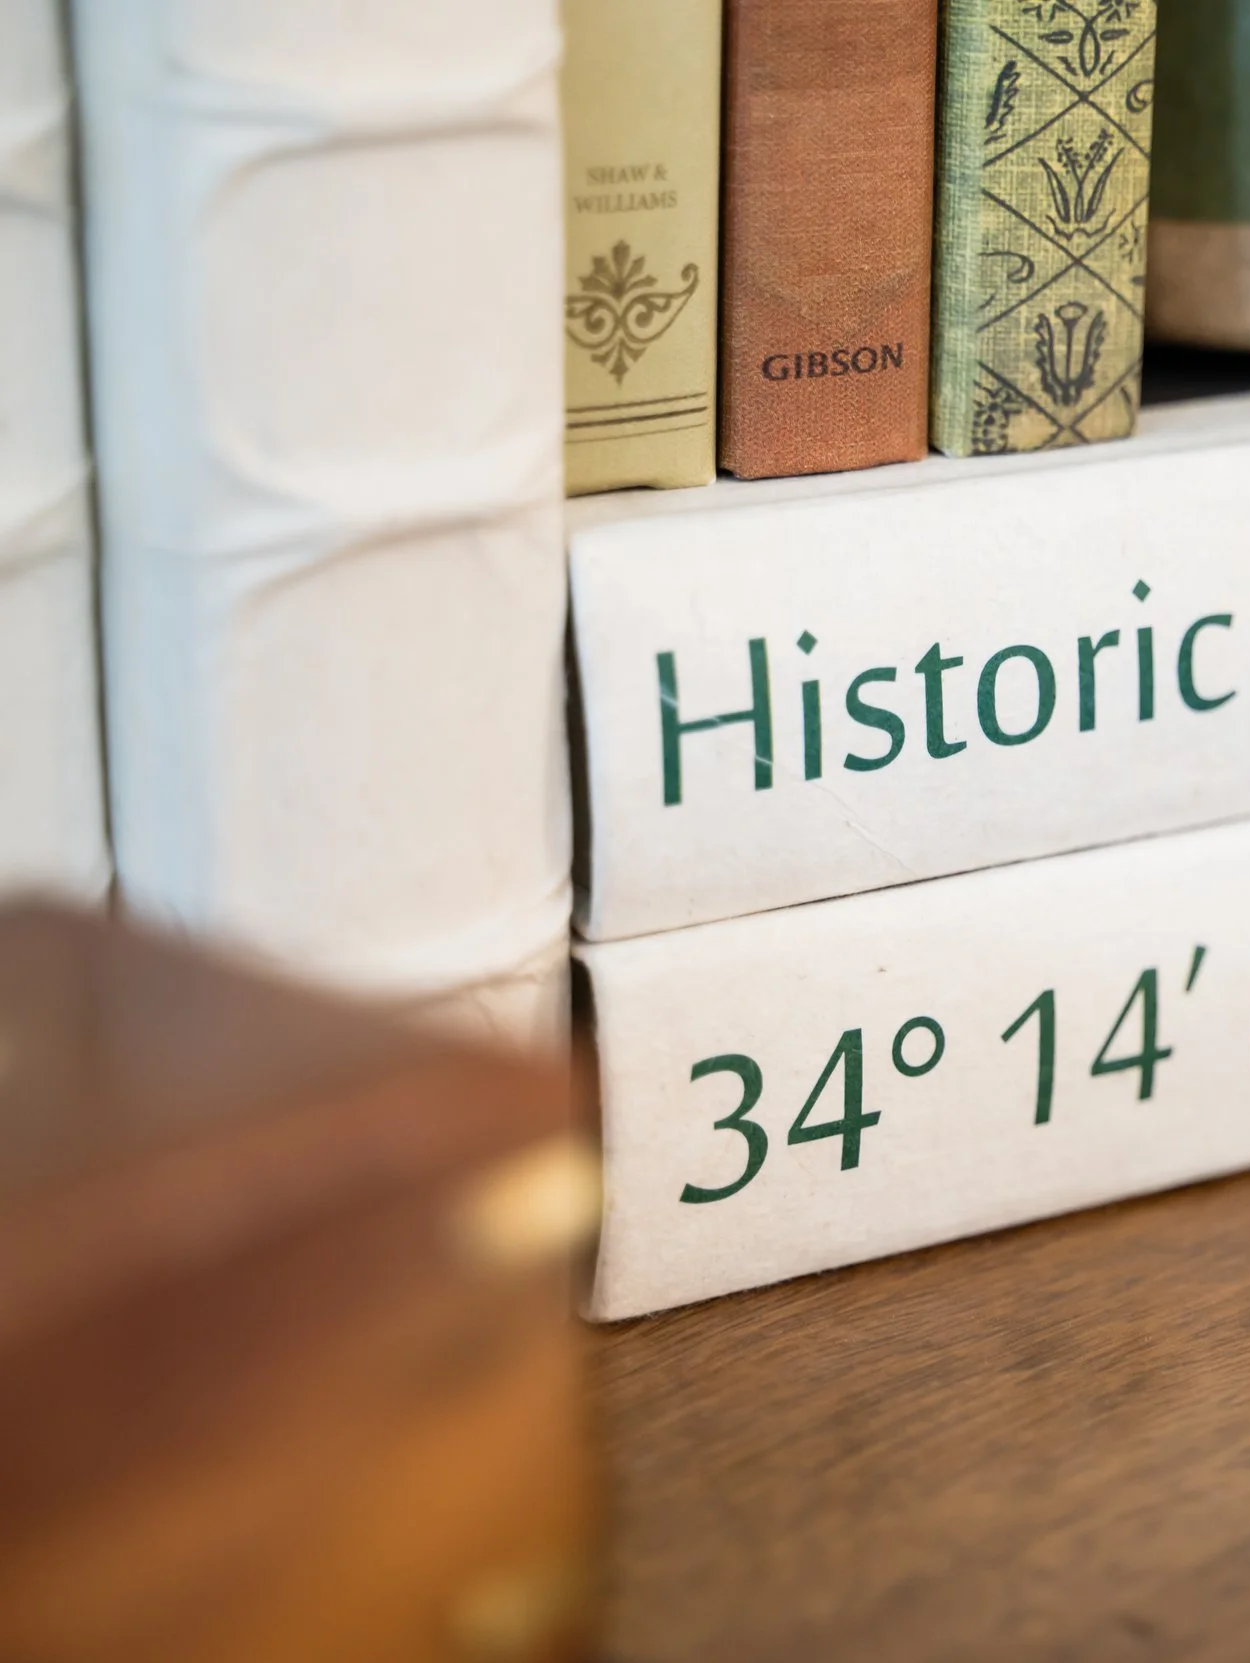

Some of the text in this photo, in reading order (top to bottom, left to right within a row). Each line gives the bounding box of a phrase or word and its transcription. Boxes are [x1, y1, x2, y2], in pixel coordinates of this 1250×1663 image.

[586, 163, 667, 184] SHAW &
[573, 190, 678, 213] WILLIAMS
[761, 342, 902, 382] GIBSON
[656, 579, 1237, 807] Historic
[679, 1016, 946, 1205] 34°
